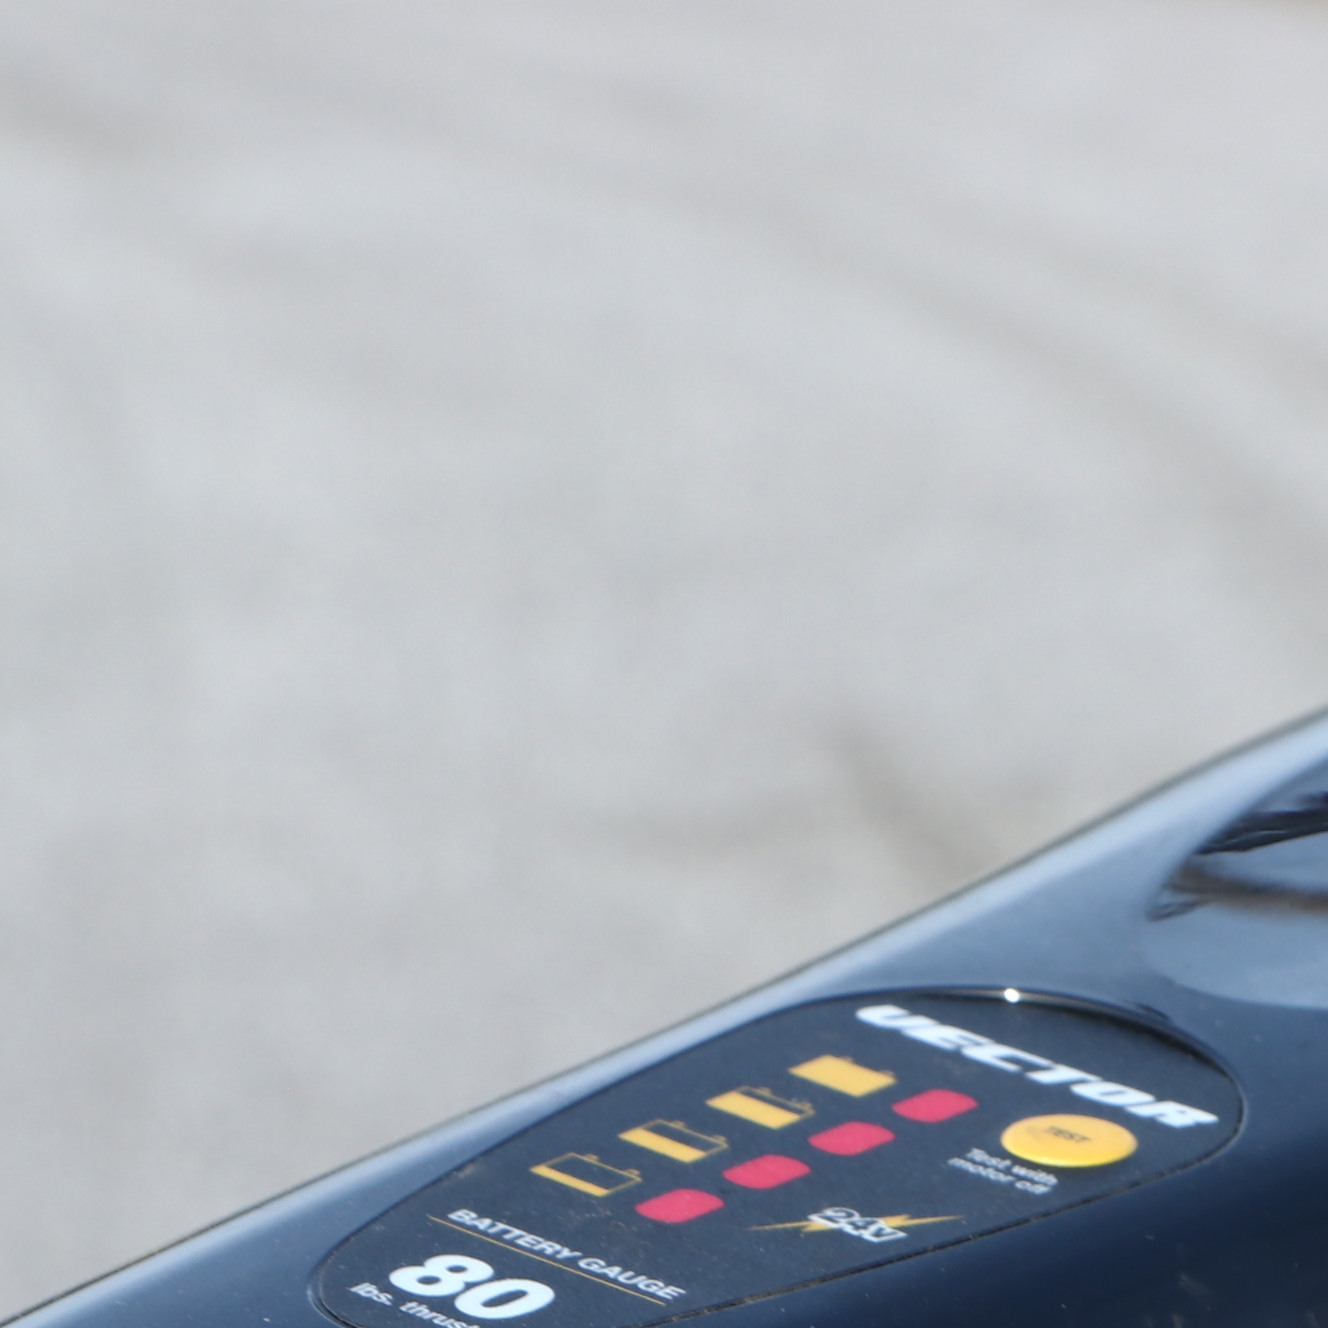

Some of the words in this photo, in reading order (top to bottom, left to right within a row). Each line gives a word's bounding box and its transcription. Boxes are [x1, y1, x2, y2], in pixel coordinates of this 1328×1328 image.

[855, 1003, 1219, 1129] VECTOR
[1045, 1125, 1092, 1144] TEST
[948, 1157, 1016, 1183] motor
[1011, 1164, 1059, 1187] with
[447, 1208, 582, 1260] BATTERY
[577, 1257, 687, 1301] GAUGE
[388, 1253, 556, 1320] 80
